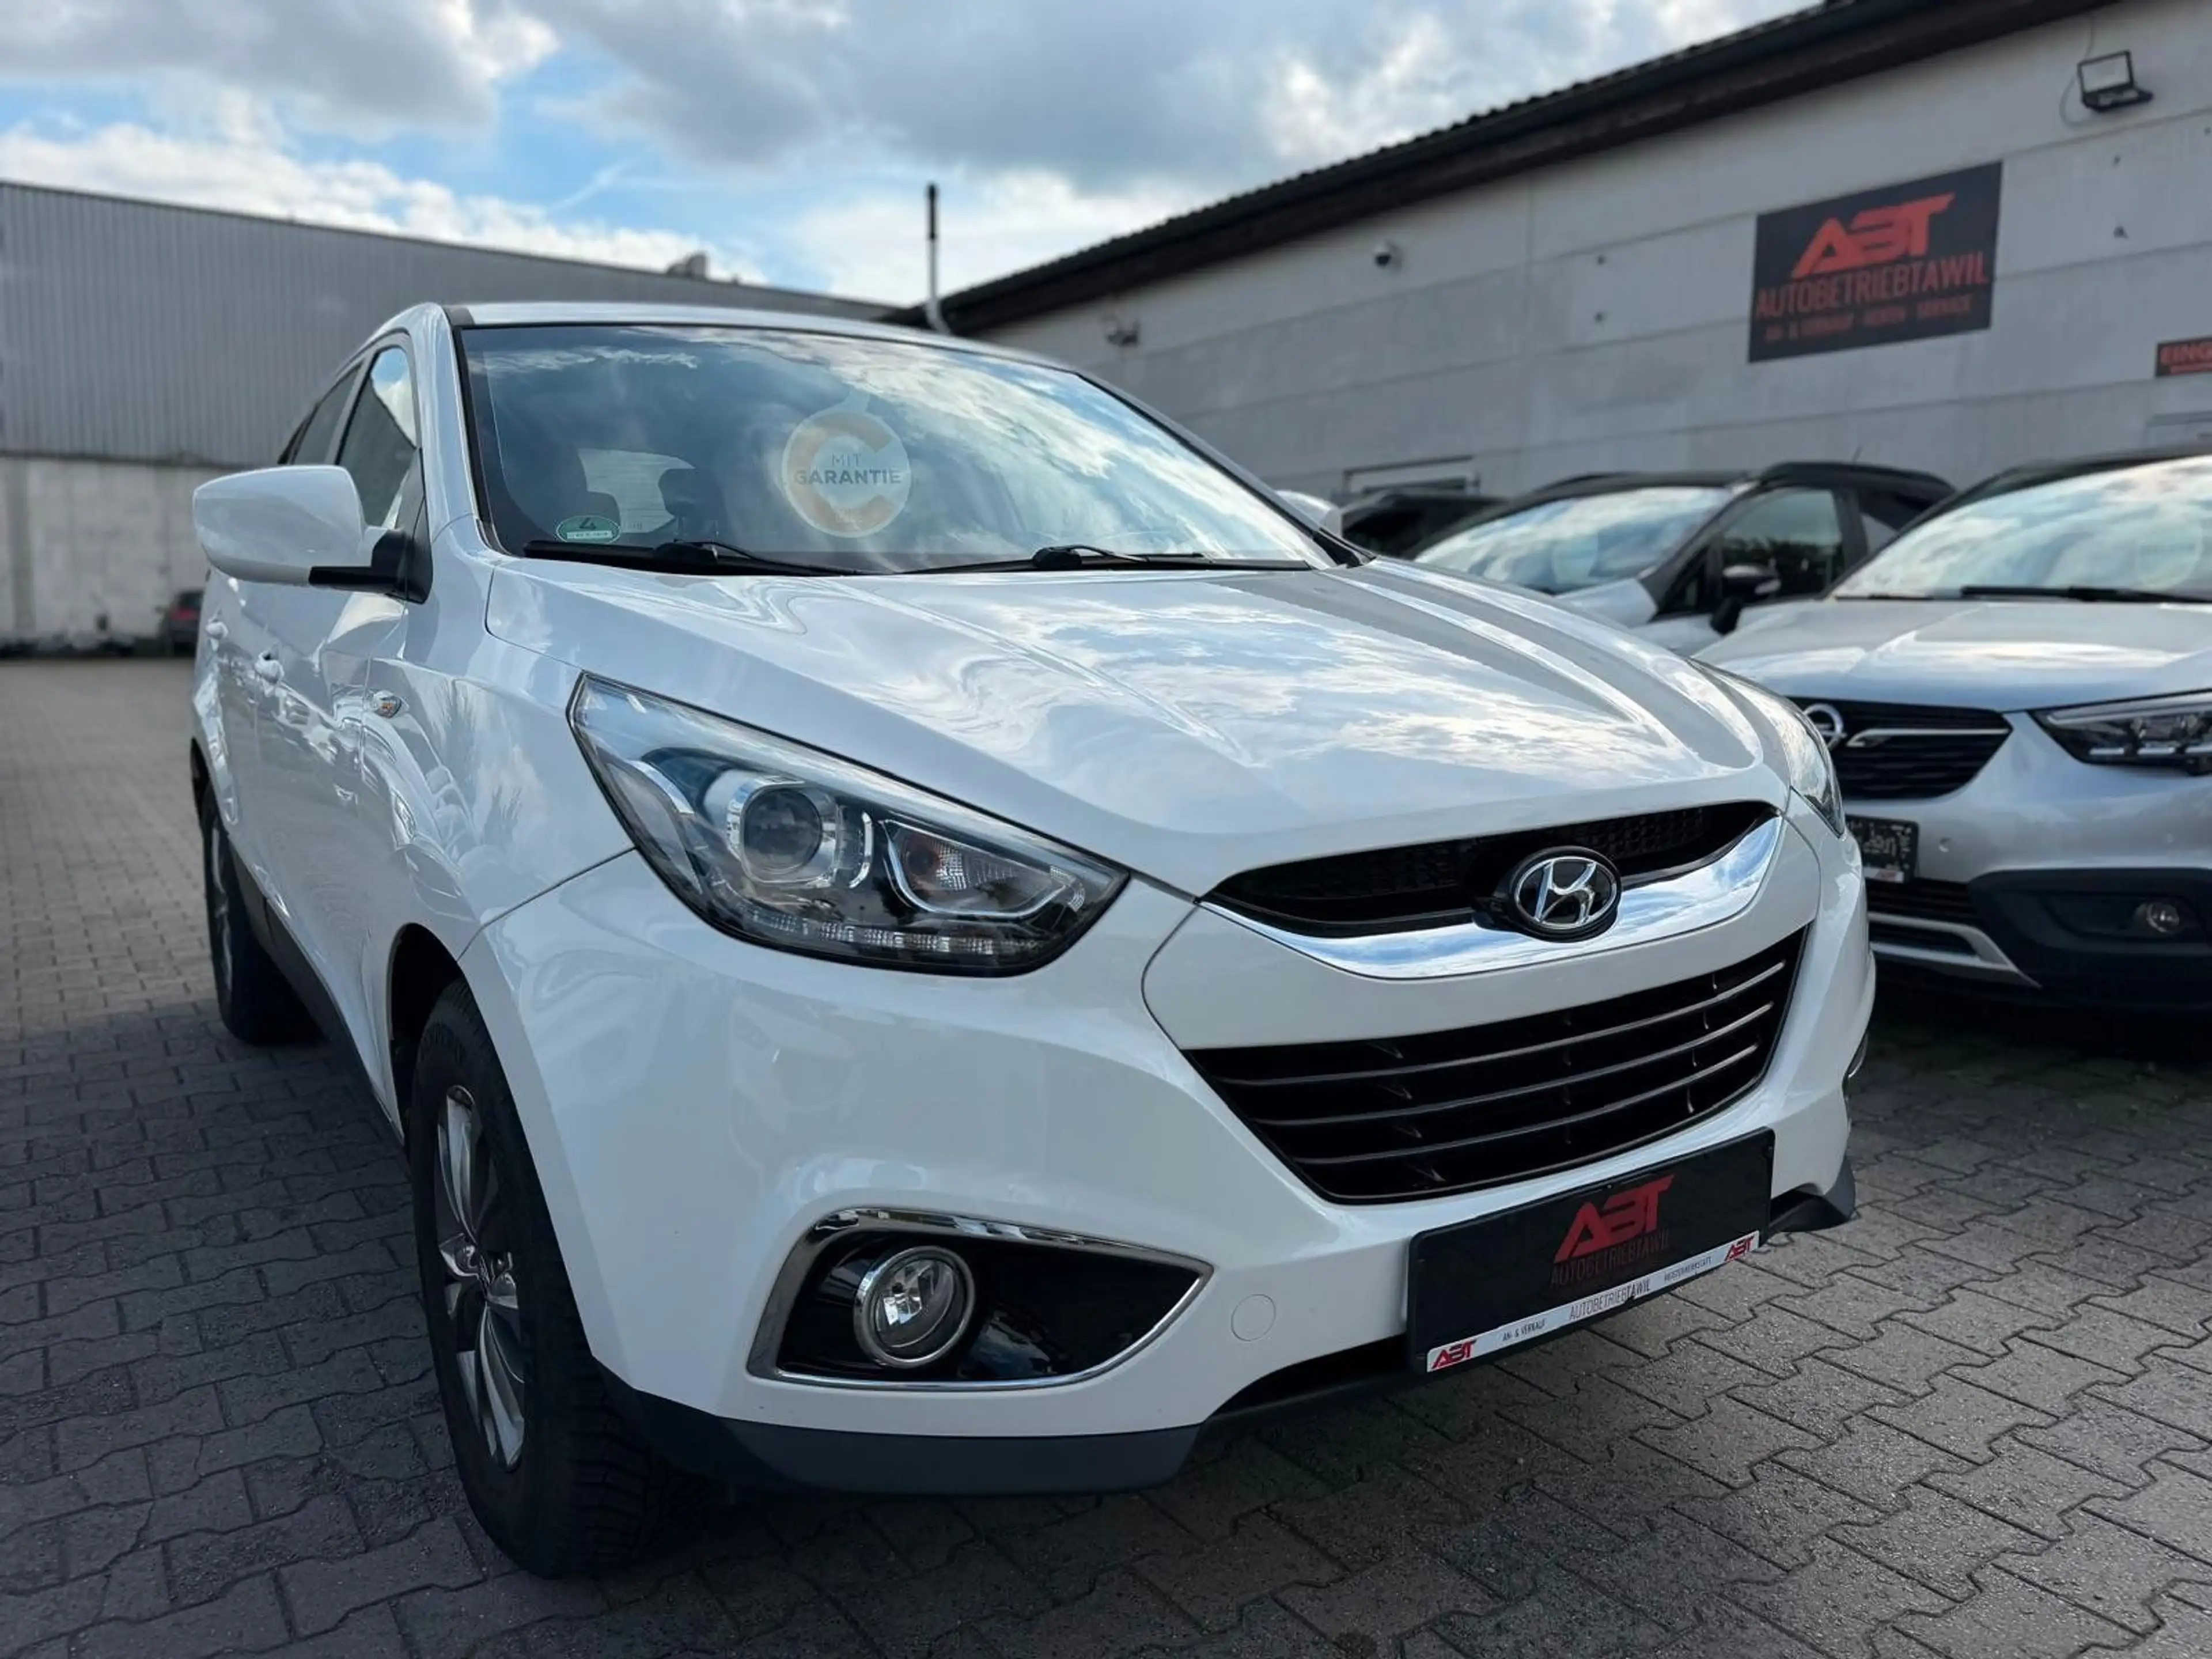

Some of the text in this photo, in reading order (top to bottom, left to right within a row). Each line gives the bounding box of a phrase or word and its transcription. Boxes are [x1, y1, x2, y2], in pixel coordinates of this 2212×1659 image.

[1755, 250, 1988, 319] AUTOBETRIEBTAWIL
[832, 453, 862, 467] MIT
[793, 469, 903, 485] GARANTIE
[1569, 1279, 1651, 1320] AUTOBETRIEBTAWIL
